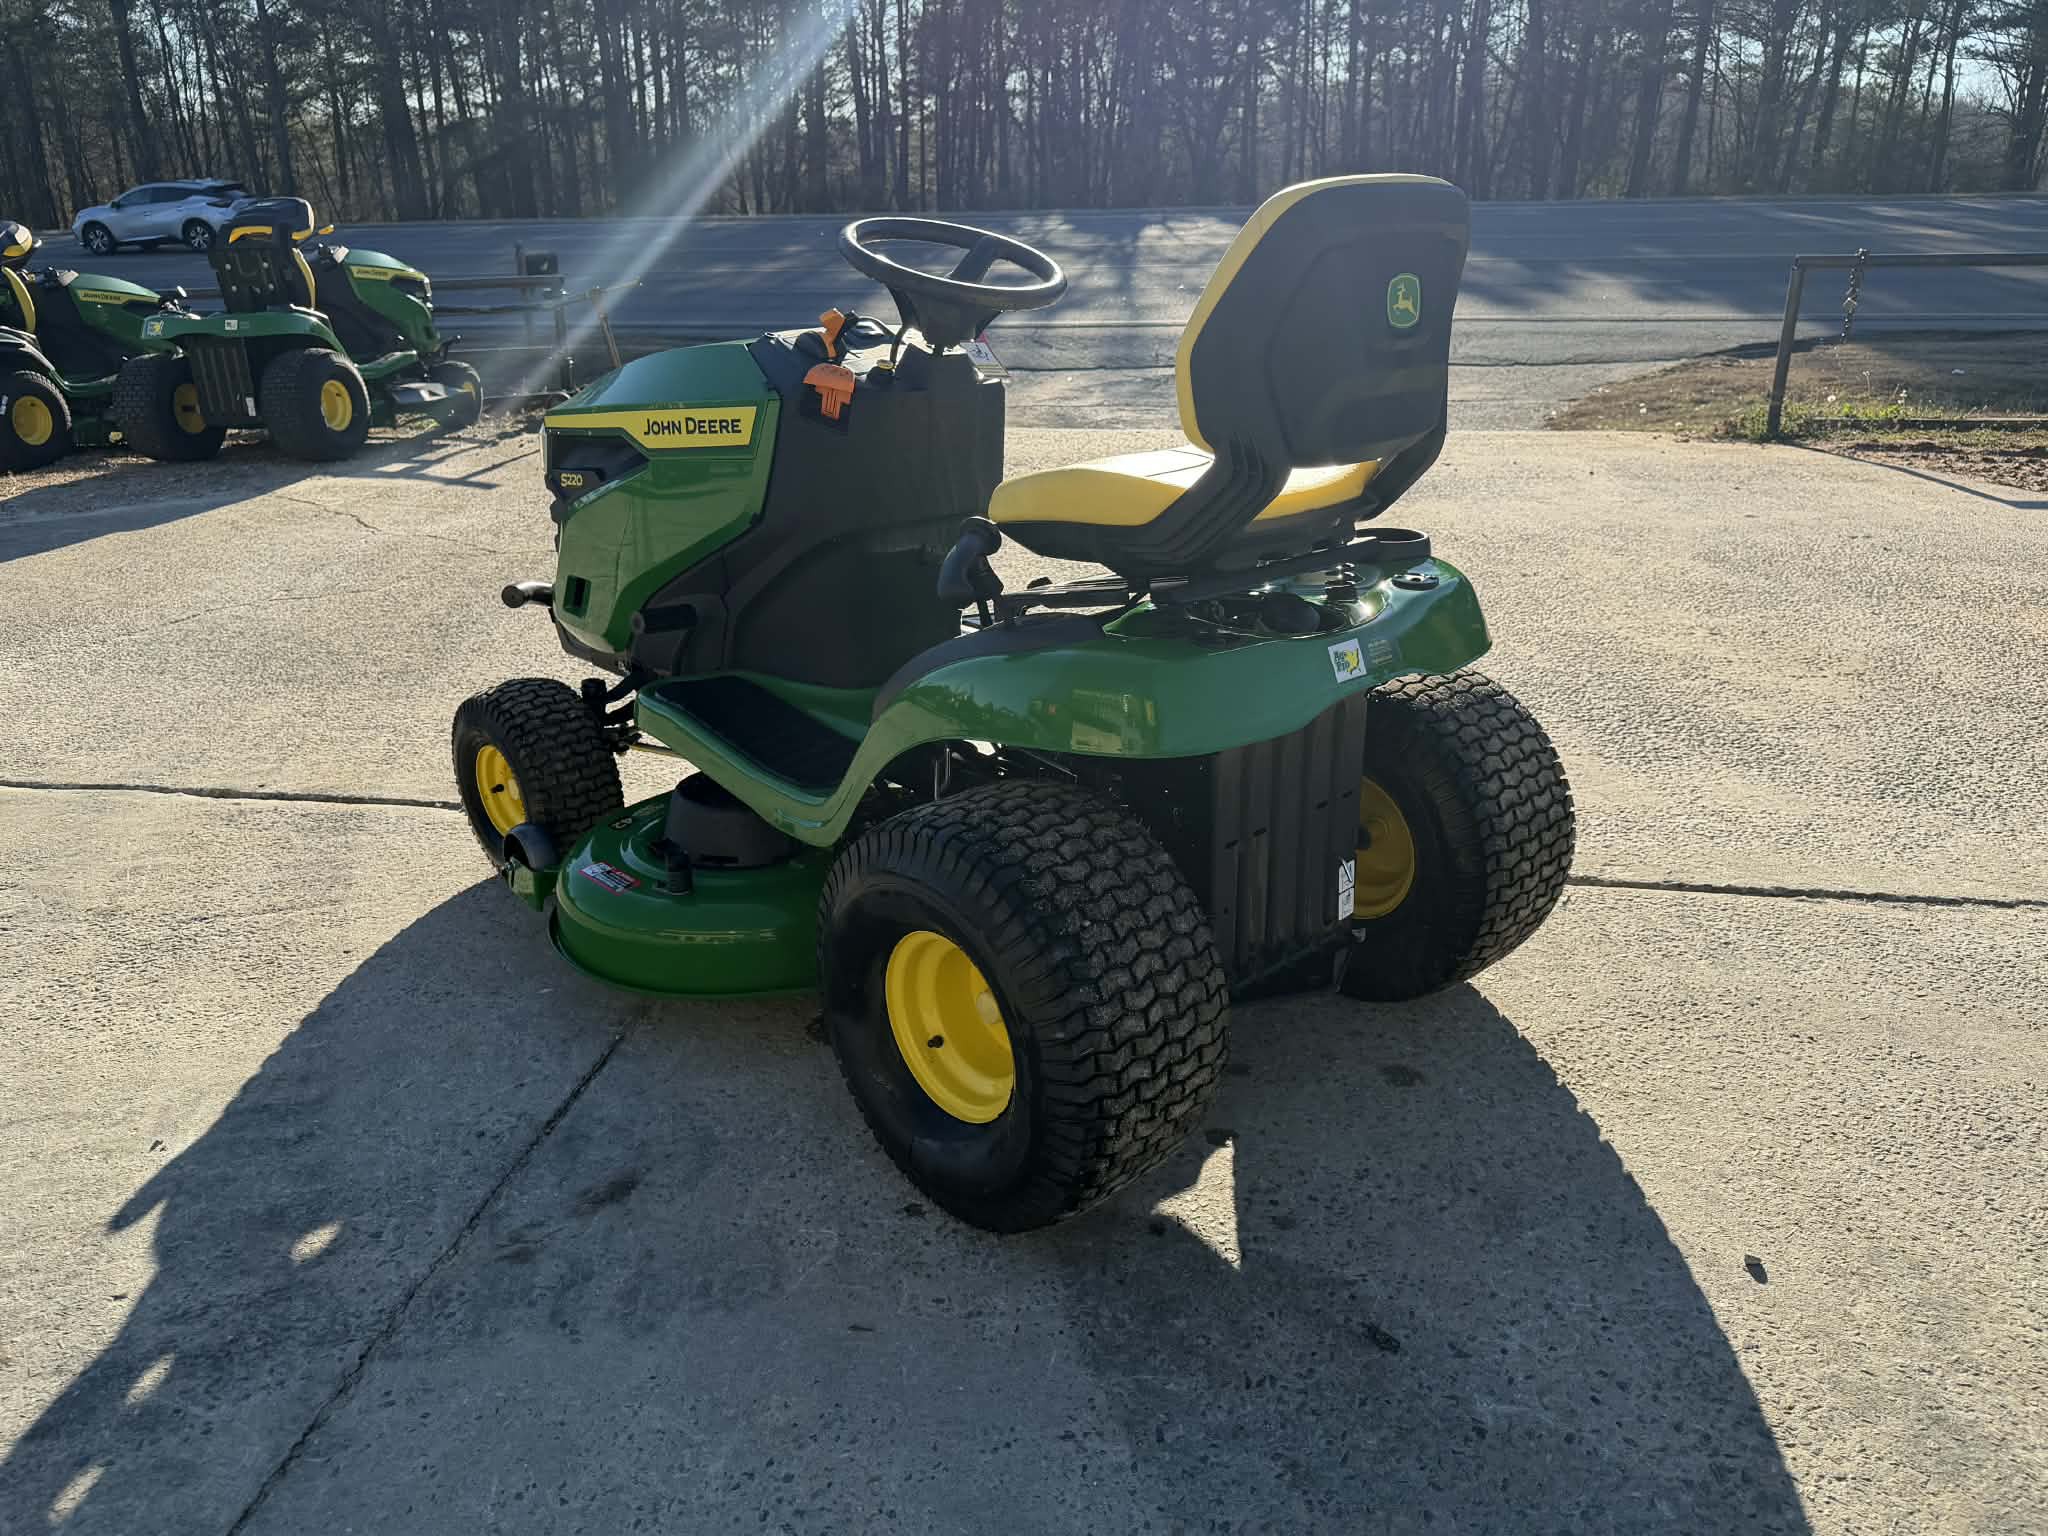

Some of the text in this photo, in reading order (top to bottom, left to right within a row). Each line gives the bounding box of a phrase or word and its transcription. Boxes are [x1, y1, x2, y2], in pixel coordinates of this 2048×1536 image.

[643, 416, 742, 436] JOHN DEERE
[560, 472, 584, 488] S220
